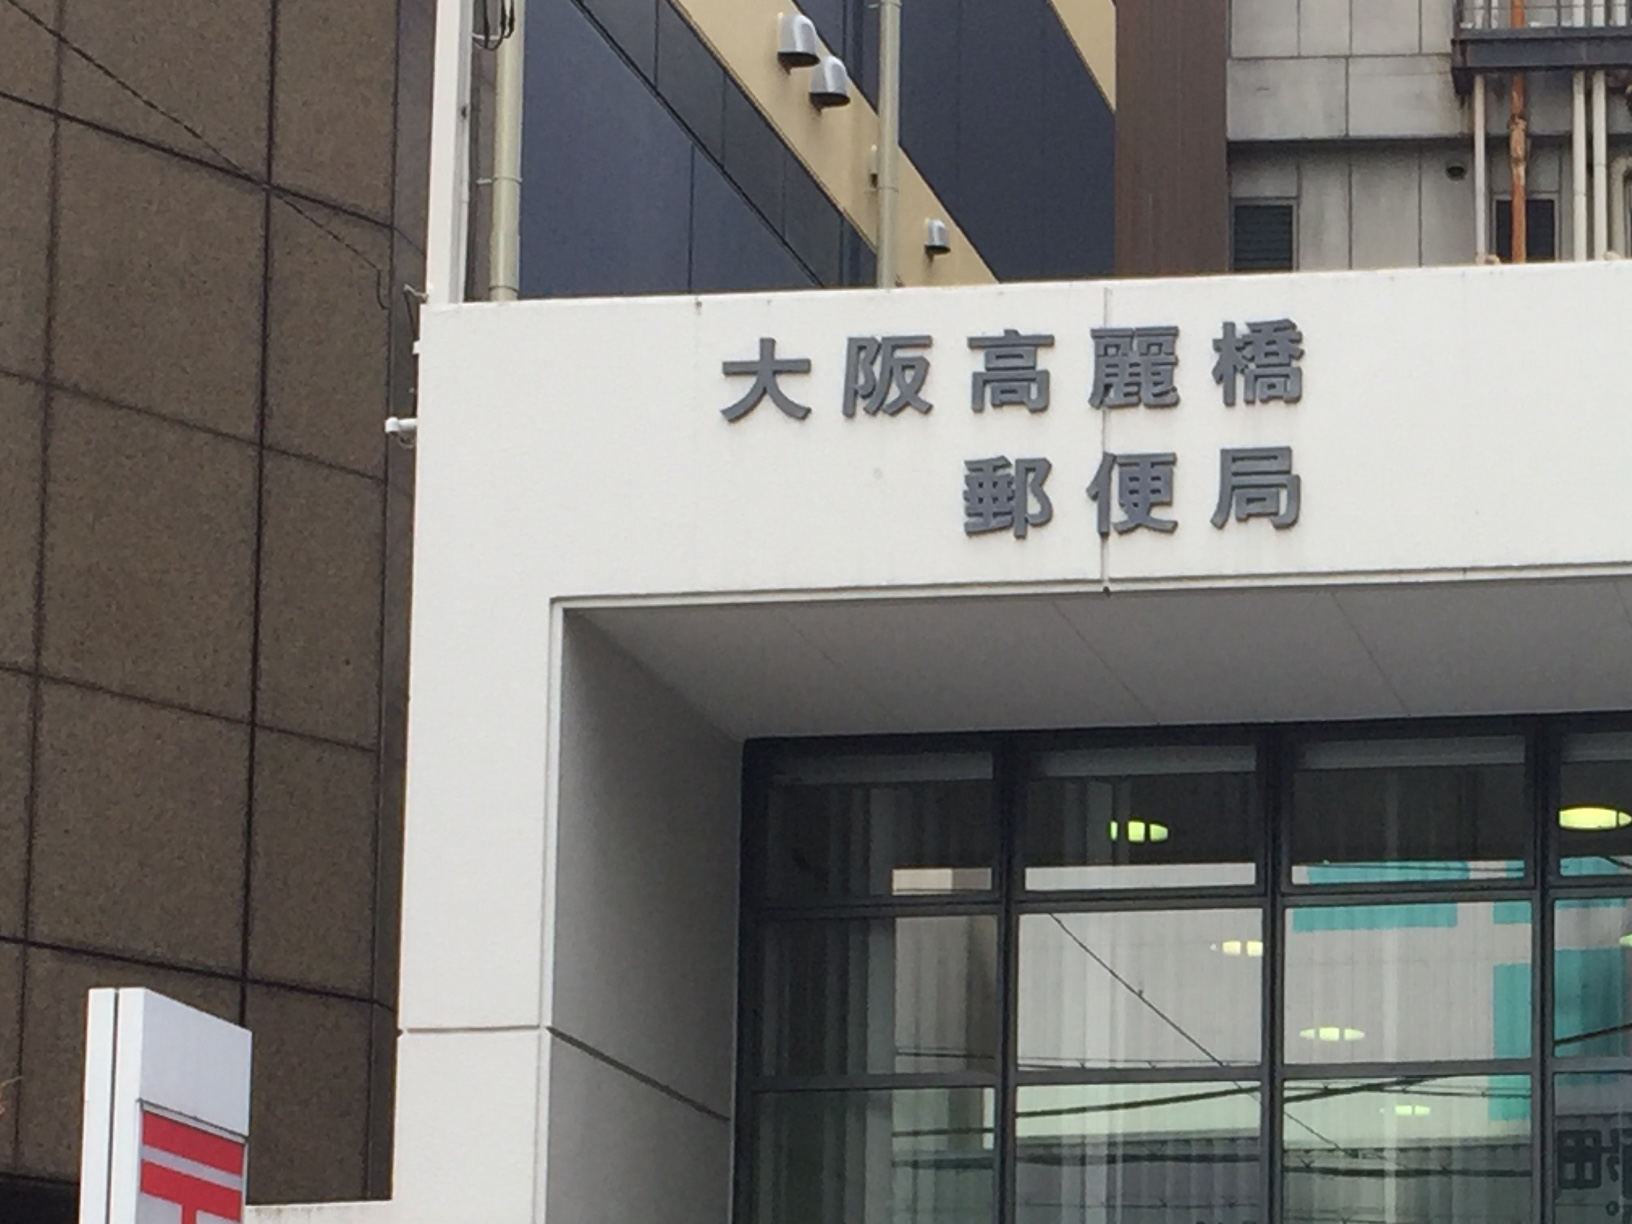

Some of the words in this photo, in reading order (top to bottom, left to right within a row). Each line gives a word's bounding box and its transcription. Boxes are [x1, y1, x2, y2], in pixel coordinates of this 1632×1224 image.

[719, 318, 1305, 423] 大阪高麗橋
[962, 446, 1301, 539] 郵便局
